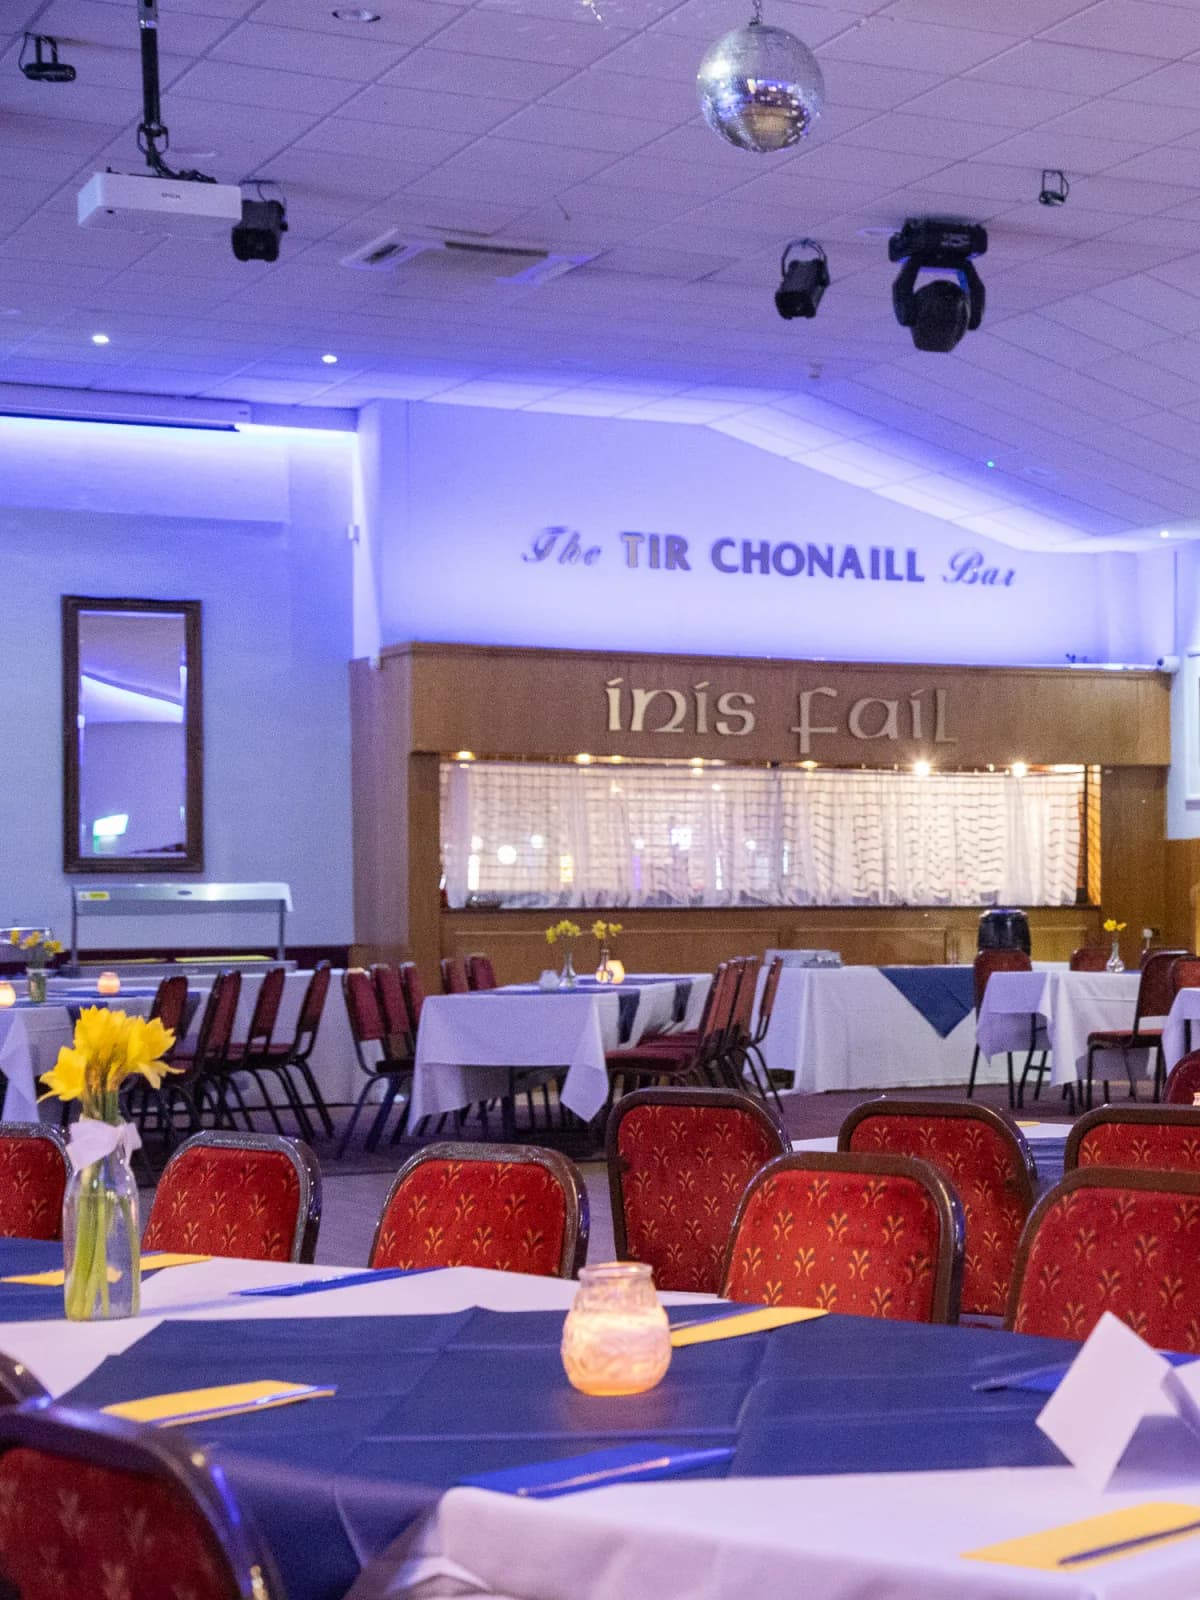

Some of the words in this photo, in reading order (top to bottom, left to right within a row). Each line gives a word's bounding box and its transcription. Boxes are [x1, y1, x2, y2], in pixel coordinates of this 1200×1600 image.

[521, 526, 602, 565] The
[620, 531, 691, 571] TIR
[711, 537, 926, 582] CHONAILL
[942, 547, 1016, 587] Bar
